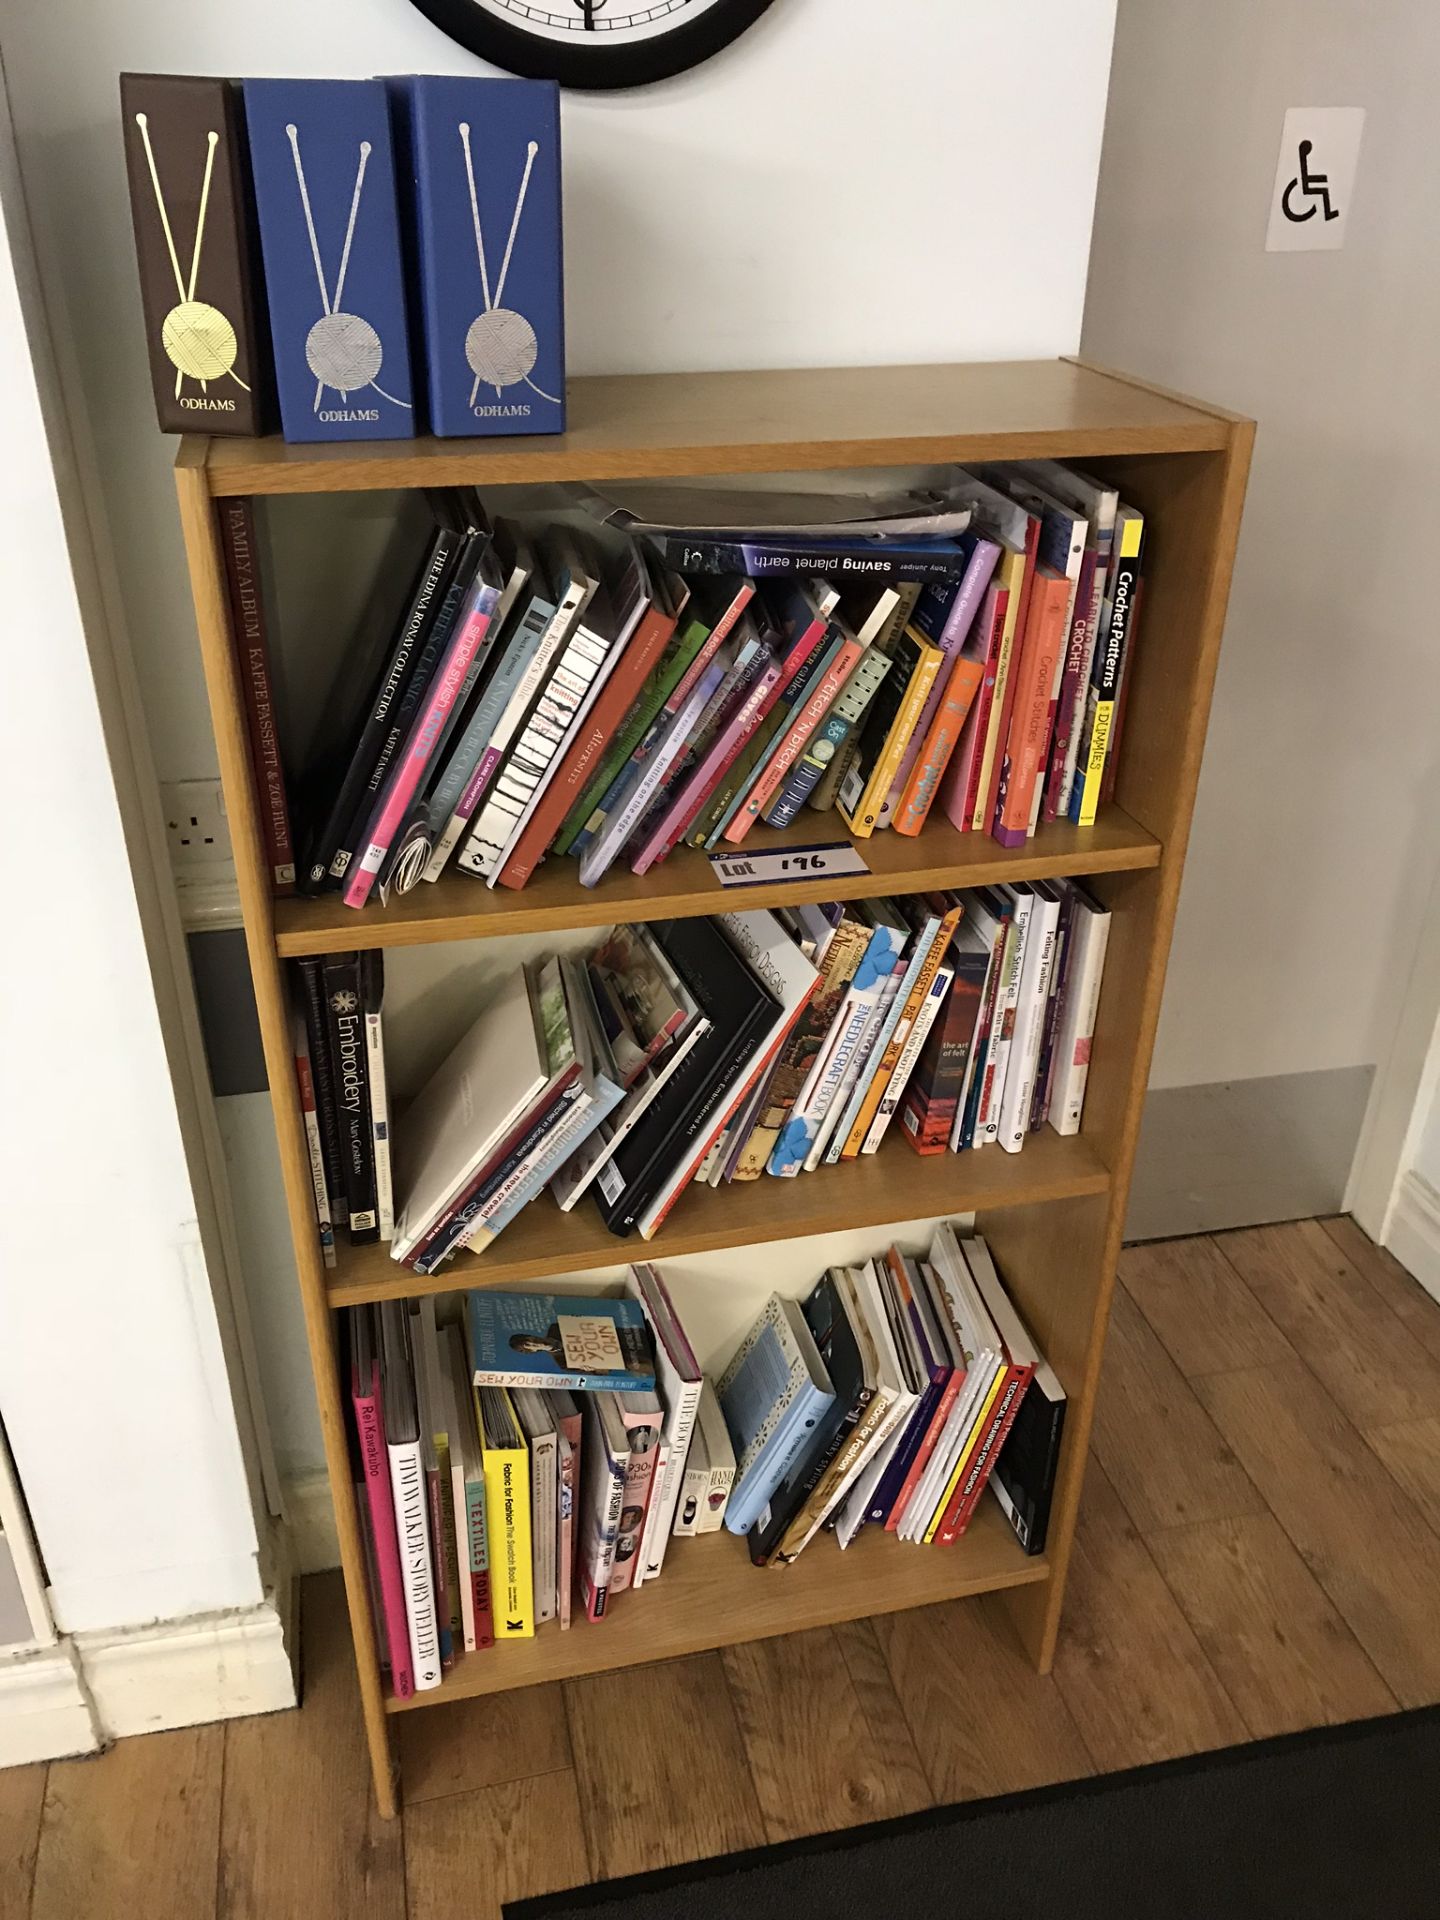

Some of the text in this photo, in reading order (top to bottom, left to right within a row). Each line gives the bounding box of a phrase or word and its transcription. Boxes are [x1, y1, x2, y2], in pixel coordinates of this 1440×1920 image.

[180, 396, 236, 411] ODHAMS
[318, 408, 380, 423] ODHAMS
[473, 404, 531, 418] ODHAMS
[754, 556, 892, 572] saving planet earth
[930, 564, 947, 573] Tony
[947, 558, 985, 635] Complete Guide to
[1086, 586, 1101, 624] LEARN
[374, 546, 449, 722] THE EDINA RONAY COLLECTION
[552, 611, 568, 633] The
[1100, 570, 1133, 688] Crochet Patterns
[451, 622, 482, 668] simple
[531, 632, 559, 675] Knitter's
[672, 605, 741, 703] knitted sock sensations
[805, 632, 829, 665] POWER
[1065, 618, 1088, 673] CROCHET
[227, 508, 288, 849] FAMILY ALBUM KAFFE FASSETT & HUNT
[434, 667, 462, 709] stylish
[785, 664, 812, 698] cables
[916, 675, 933, 699] Knit
[1033, 654, 1053, 698] Crochet
[1073, 647, 1090, 701] CROCHET
[471, 678, 508, 738] KNITTING
[550, 683, 578, 706] knitting
[737, 683, 768, 725] Gloves
[905, 699, 921, 722] your
[829, 720, 846, 734] Cast
[1025, 700, 1044, 743] Stitches
[891, 743, 904, 760] Pet
[1090, 712, 1109, 770] DUMMIES
[367, 726, 401, 792] KAFFE FASSETT
[643, 755, 667, 789] knitting
[462, 754, 495, 810] CLAIRE CROMPTON
[636, 787, 646, 799] on
[628, 799, 641, 814] the
[615, 813, 632, 834] edge
[720, 861, 756, 877] Lot
[782, 855, 826, 870] 196
[927, 932, 947, 961] KAFFE
[1006, 910, 1028, 998] Embellish Stitch Felt
[1036, 929, 1055, 994] Felting Fashion
[912, 960, 935, 997] FASSETT
[858, 1003, 872, 1012] THE
[332, 1014, 368, 1114] Embroidery
[811, 1008, 869, 1119] NEEDLECRAFT BOOK
[887, 1001, 932, 1097] KNOTS AND KNOT TYING
[722, 1062, 738, 1083] Taylor
[540, 1119, 549, 1128] in
[545, 1098, 567, 1123] Stitched
[686, 1081, 726, 1136] Embroidered Art
[349, 1119, 360, 1138] Mary
[502, 1105, 594, 1210] EMBROIDERED EFFECTS
[312, 1162, 327, 1209] STITCHING
[480, 1162, 530, 1220] the new crewel
[566, 1334, 586, 1363] SEW
[579, 1322, 604, 1361] YOUR
[598, 1324, 620, 1355] OWN
[478, 1374, 573, 1386] SEW YOUR OWN
[996, 1379, 1018, 1420] TECHNICAL
[672, 1388, 698, 1456] THE BOOT
[838, 1399, 890, 1471] Fabric for Fashion
[982, 1418, 1001, 1451] DRAWING
[360, 1405, 382, 1477] Rei Kawakubo
[503, 1463, 512, 1485] Fabric
[711, 1471, 734, 1479] HAND
[975, 1450, 987, 1467] FOR
[504, 1487, 513, 1497] for
[612, 1482, 623, 1493] OF
[963, 1466, 980, 1495] FASHION
[504, 1498, 514, 1525] Fashion
[608, 1494, 622, 1520] FASHION
[506, 1526, 514, 1537] The
[400, 1454, 434, 1659] TIM WALKER STORY TELLER
[469, 1500, 488, 1611] TEXTILES TODAY
[506, 1540, 516, 1564] Swatch
[508, 1566, 516, 1582] Book
